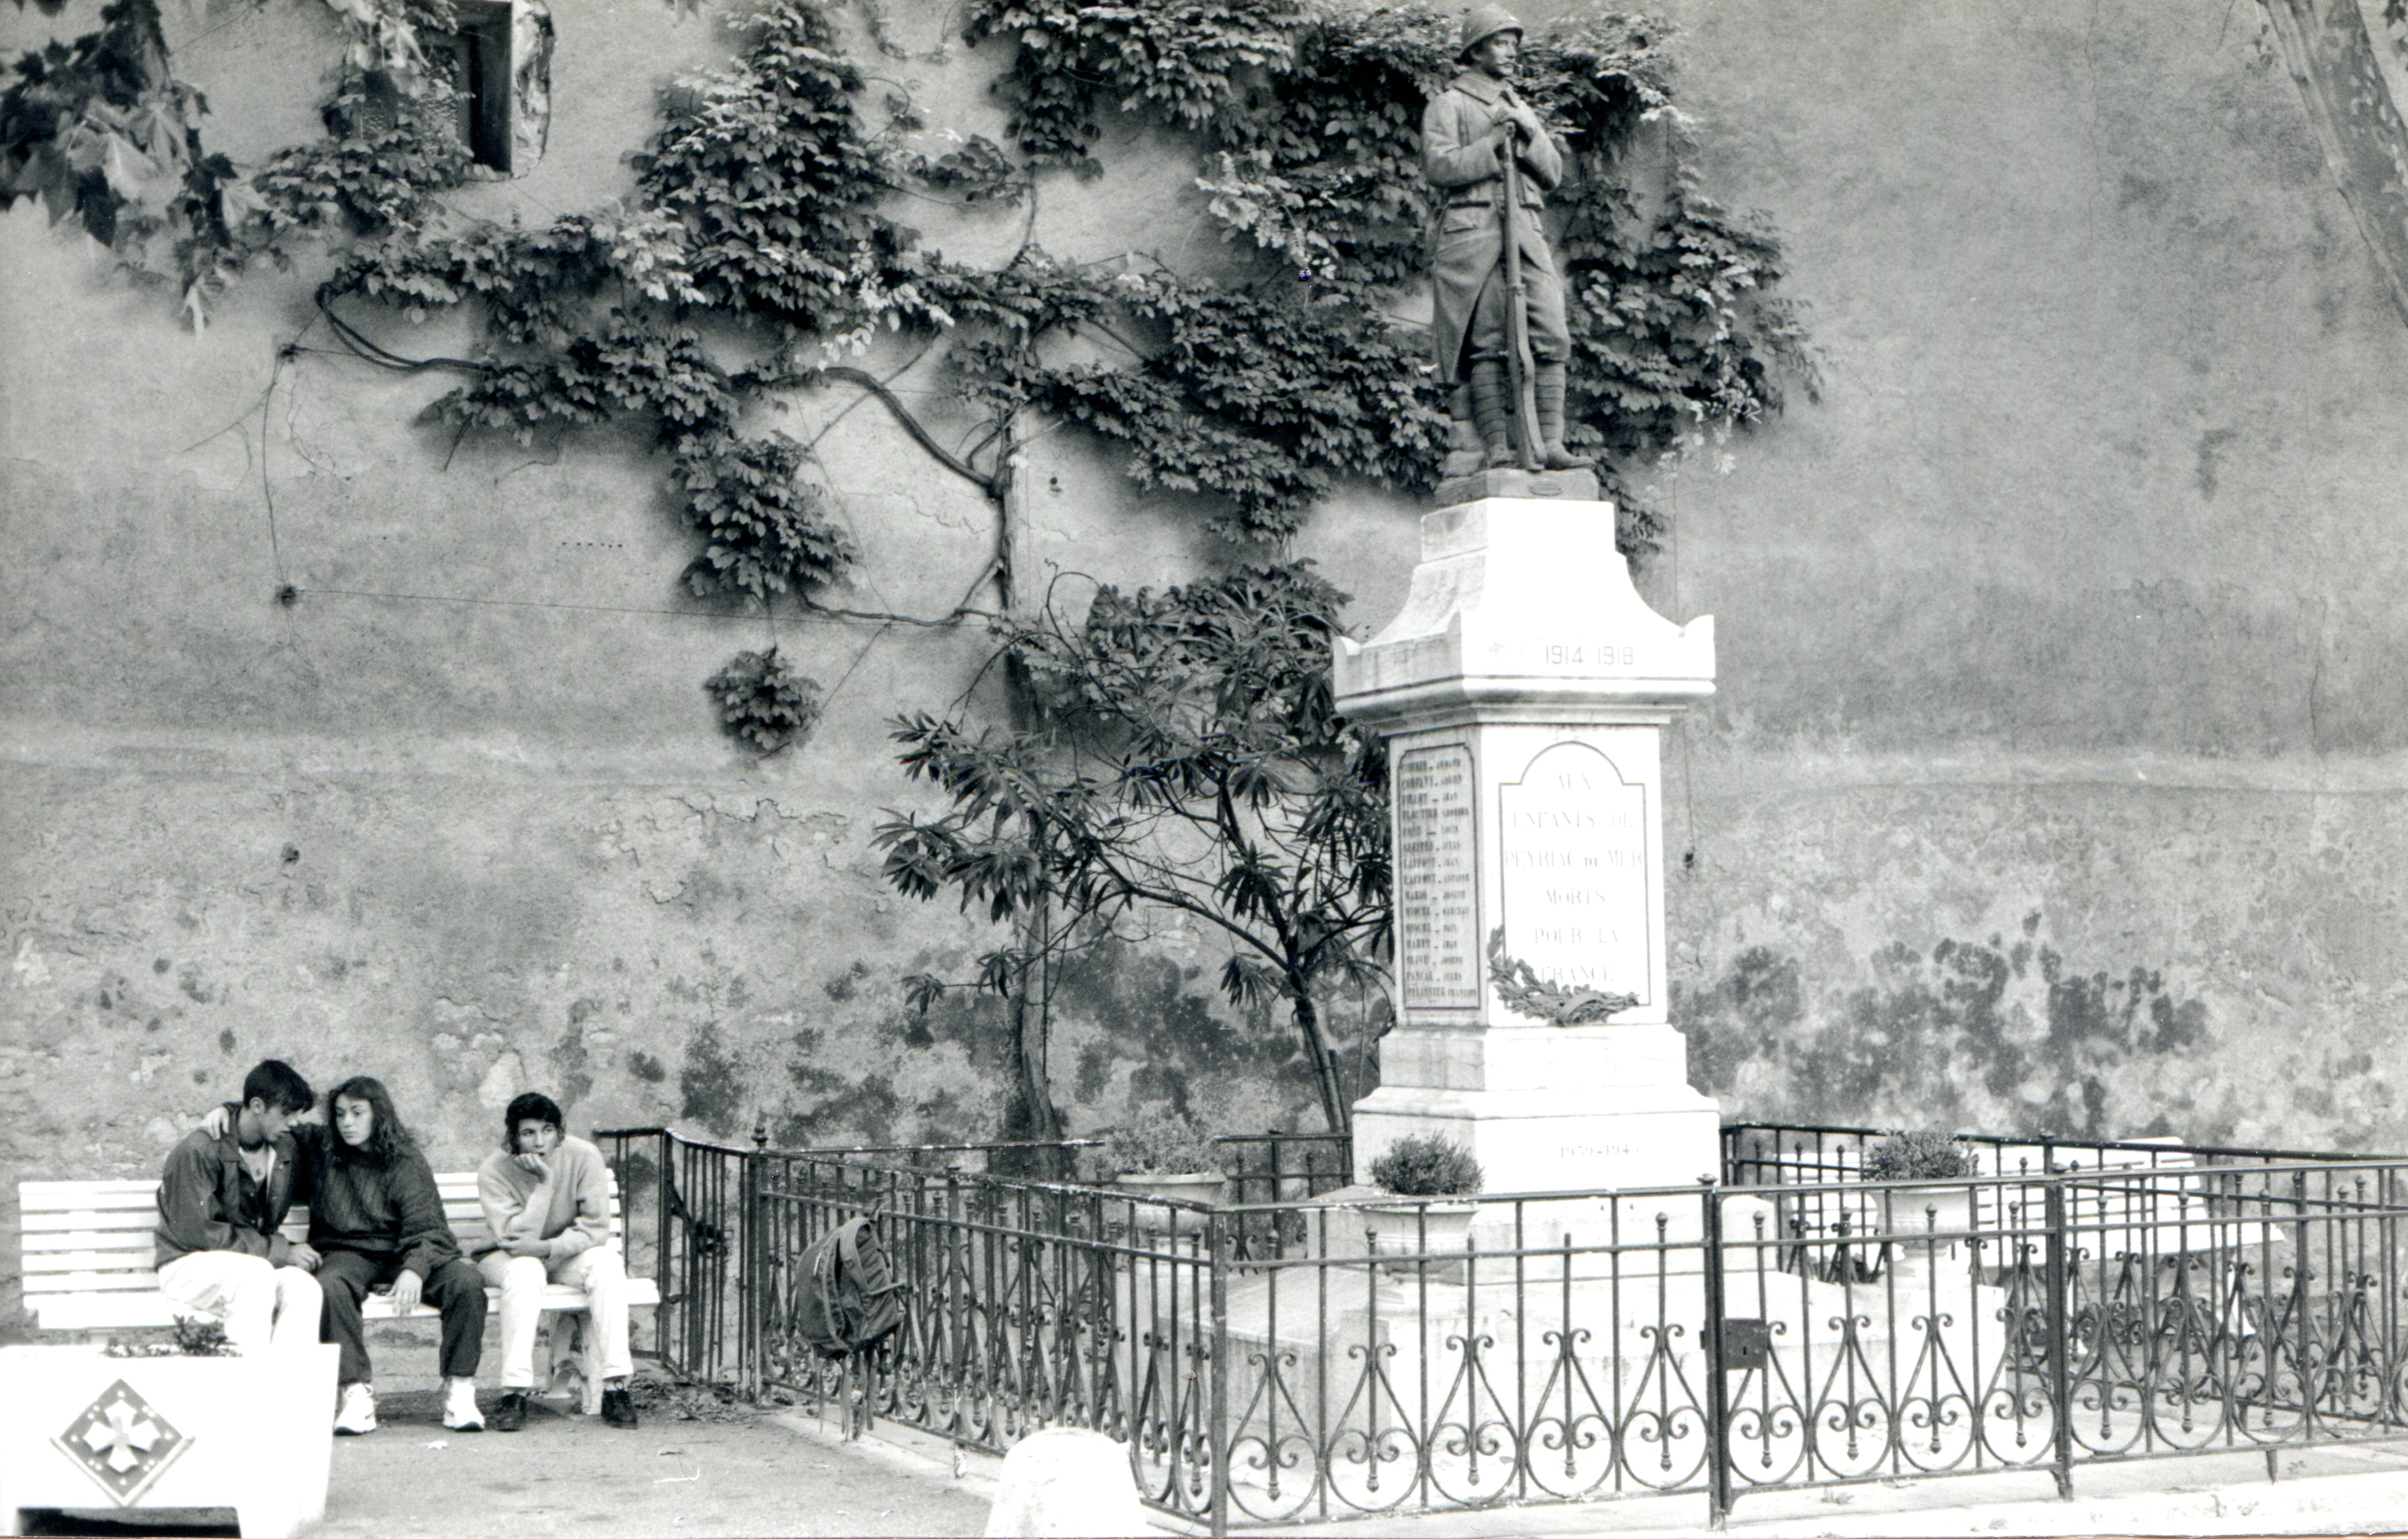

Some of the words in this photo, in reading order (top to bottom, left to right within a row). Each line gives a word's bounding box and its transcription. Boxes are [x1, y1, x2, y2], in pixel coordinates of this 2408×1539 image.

[1556, 773, 1591, 790] AUX
[1513, 812, 1595, 828] ENFANTS
[1612, 812, 1634, 828] DE
[1505, 850, 1578, 867] PEYRIAC
[1608, 850, 1642, 866] MER
[1546, 889, 1605, 905] MORTS
[1535, 927, 1582, 944] POUR
[1598, 927, 1619, 943] LA
[1541, 966, 1614, 982] FRANCE
